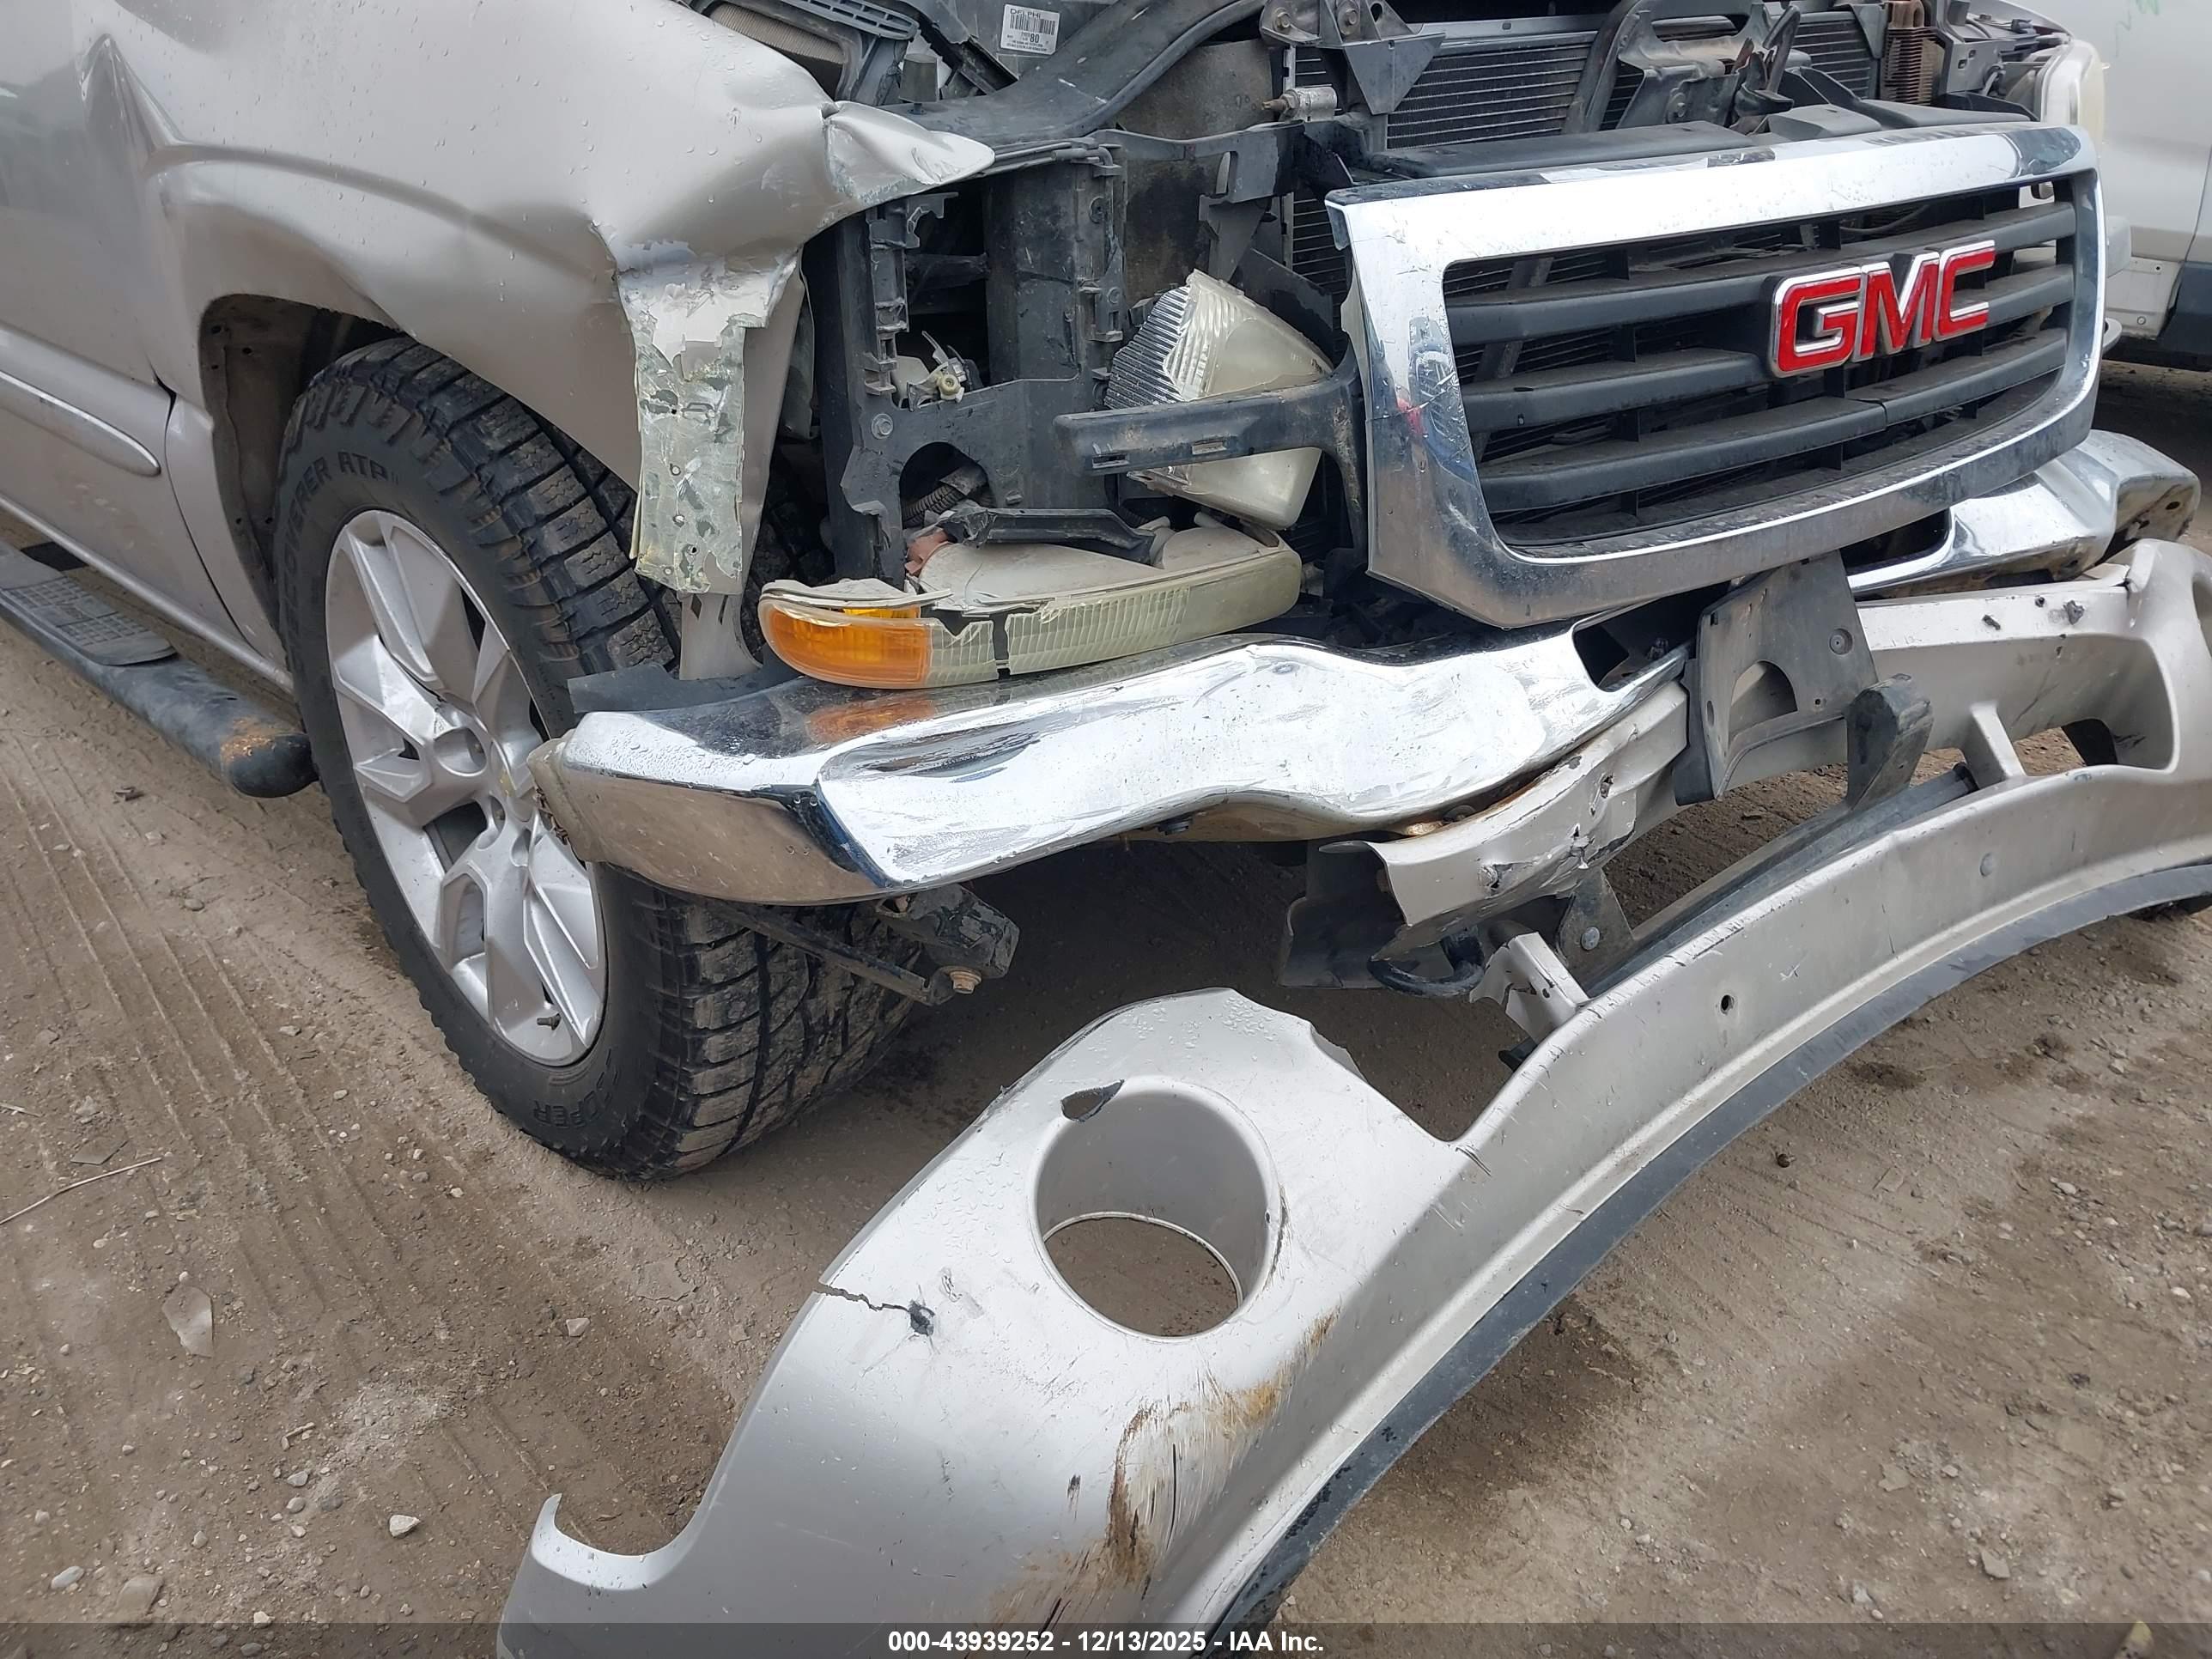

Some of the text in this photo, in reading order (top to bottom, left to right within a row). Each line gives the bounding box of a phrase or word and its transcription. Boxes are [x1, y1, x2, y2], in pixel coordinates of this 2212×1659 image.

[1010, 9, 1041, 18] DELPHI
[1030, 33, 1040, 43] 80
[1770, 240, 1996, 379] GMC
